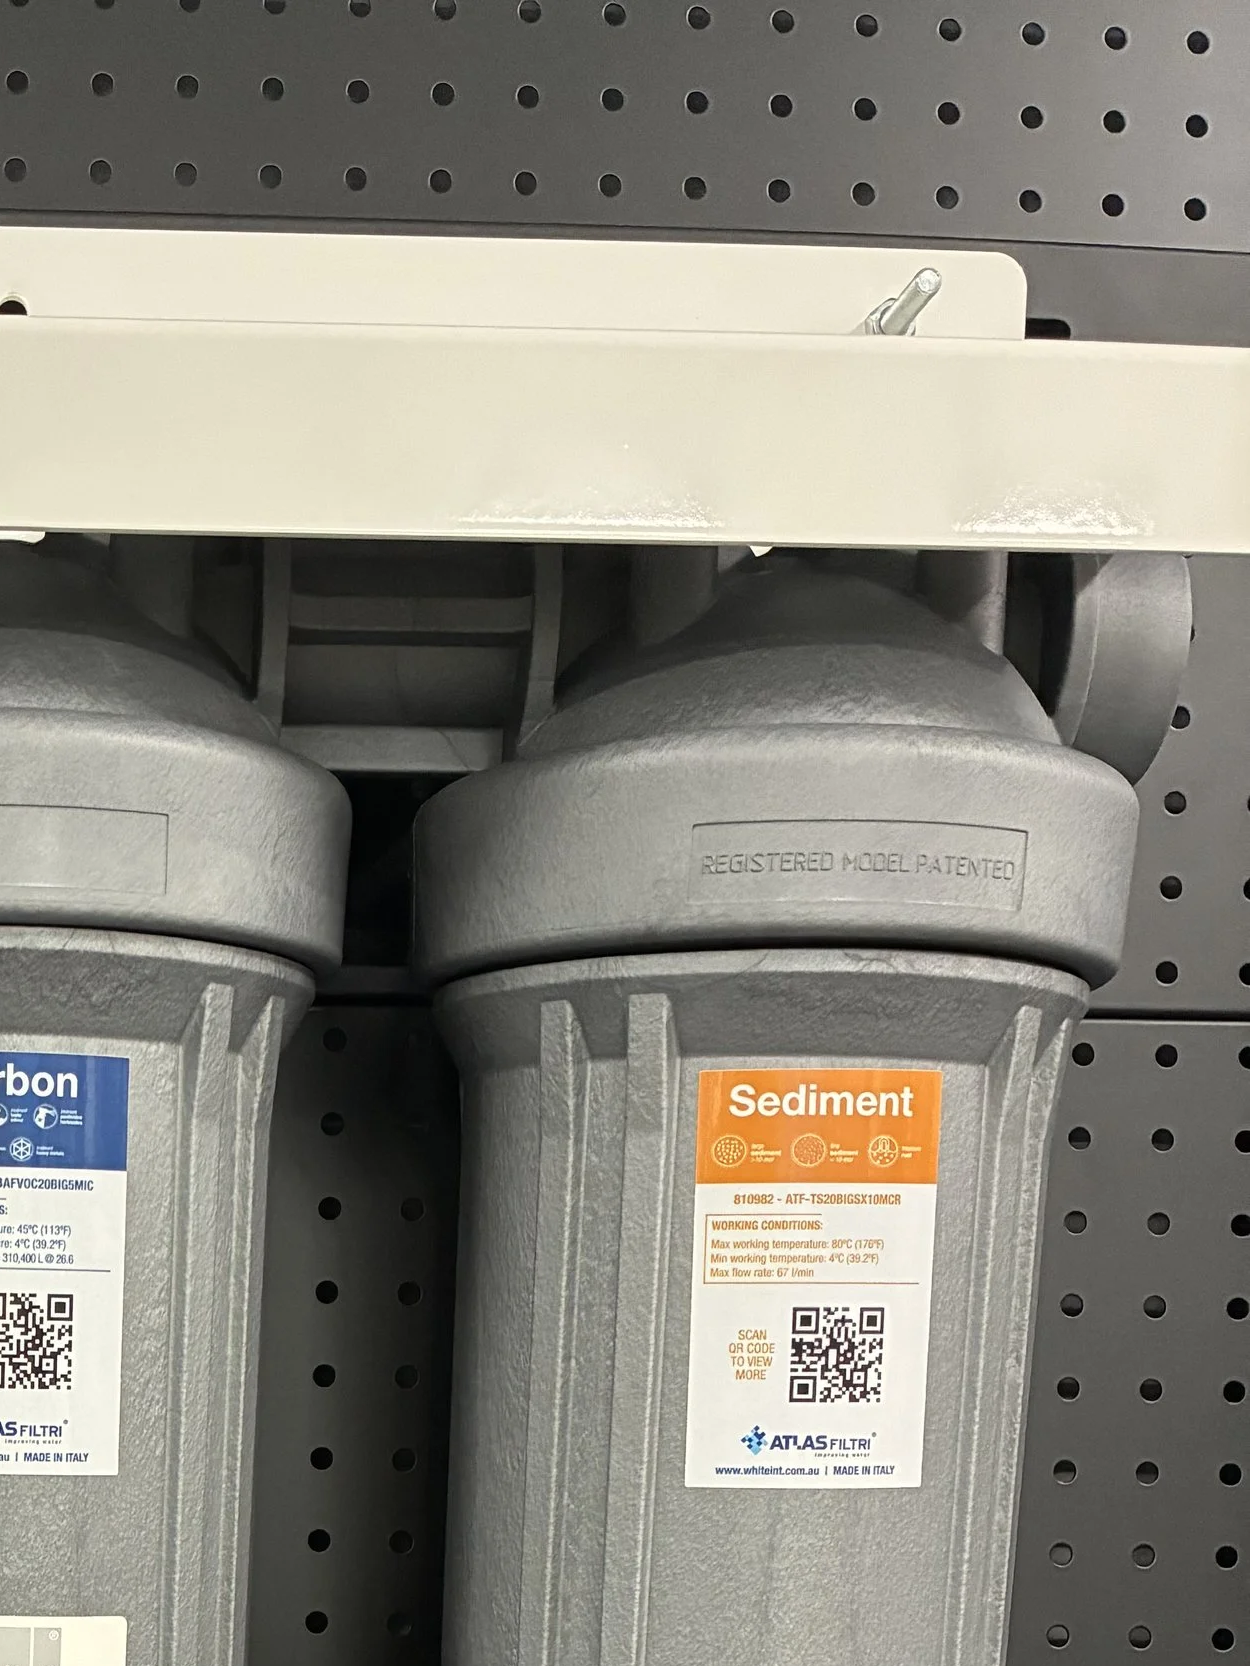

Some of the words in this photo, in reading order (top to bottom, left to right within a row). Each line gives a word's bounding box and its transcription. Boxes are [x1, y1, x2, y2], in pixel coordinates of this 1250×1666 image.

[702, 852, 834, 875] REGISTERED
[842, 853, 910, 872] MODEL
[915, 854, 1015, 881] PATENTED
[729, 1083, 913, 1117] Sediment
[734, 1194, 773, 1205] 810982
[712, 1221, 758, 1230] WORKING
[761, 1221, 823, 1230] CONDITIONS:
[711, 1239, 731, 1249] Max
[733, 1239, 770, 1251] working
[772, 1239, 829, 1251] temperature:
[2, 1253, 36, 1264] 310,400
[56, 1254, 74, 1264] 26.6
[711, 1254, 727, 1263] Min
[730, 1254, 767, 1266] working
[769, 1254, 826, 1266] temperature:
[710, 1268, 730, 1277] Max
[732, 1268, 751, 1277] flow
[754, 1269, 775, 1277] rate:
[777, 1268, 788, 1277] 67
[738, 1330, 767, 1340] SCAN
[728, 1343, 743, 1355] QR
[746, 1343, 775, 1355] CODE
[731, 1356, 745, 1366] TO
[747, 1356, 773, 1366] VIEW
[735, 1369, 766, 1380] MORE
[20, 1425, 62, 1437] FILTRI
[770, 1435, 828, 1450] ATLAS
[830, 1439, 871, 1450] FILTRI
[24, 1452, 50, 1462] MADE
[53, 1453, 62, 1462] IN
[66, 1453, 89, 1462] ITALY
[715, 1467, 819, 1476] www.whiteint.com.au
[833, 1466, 859, 1475] MADE
[862, 1466, 871, 1475] IN
[873, 1465, 895, 1475] ITALY
